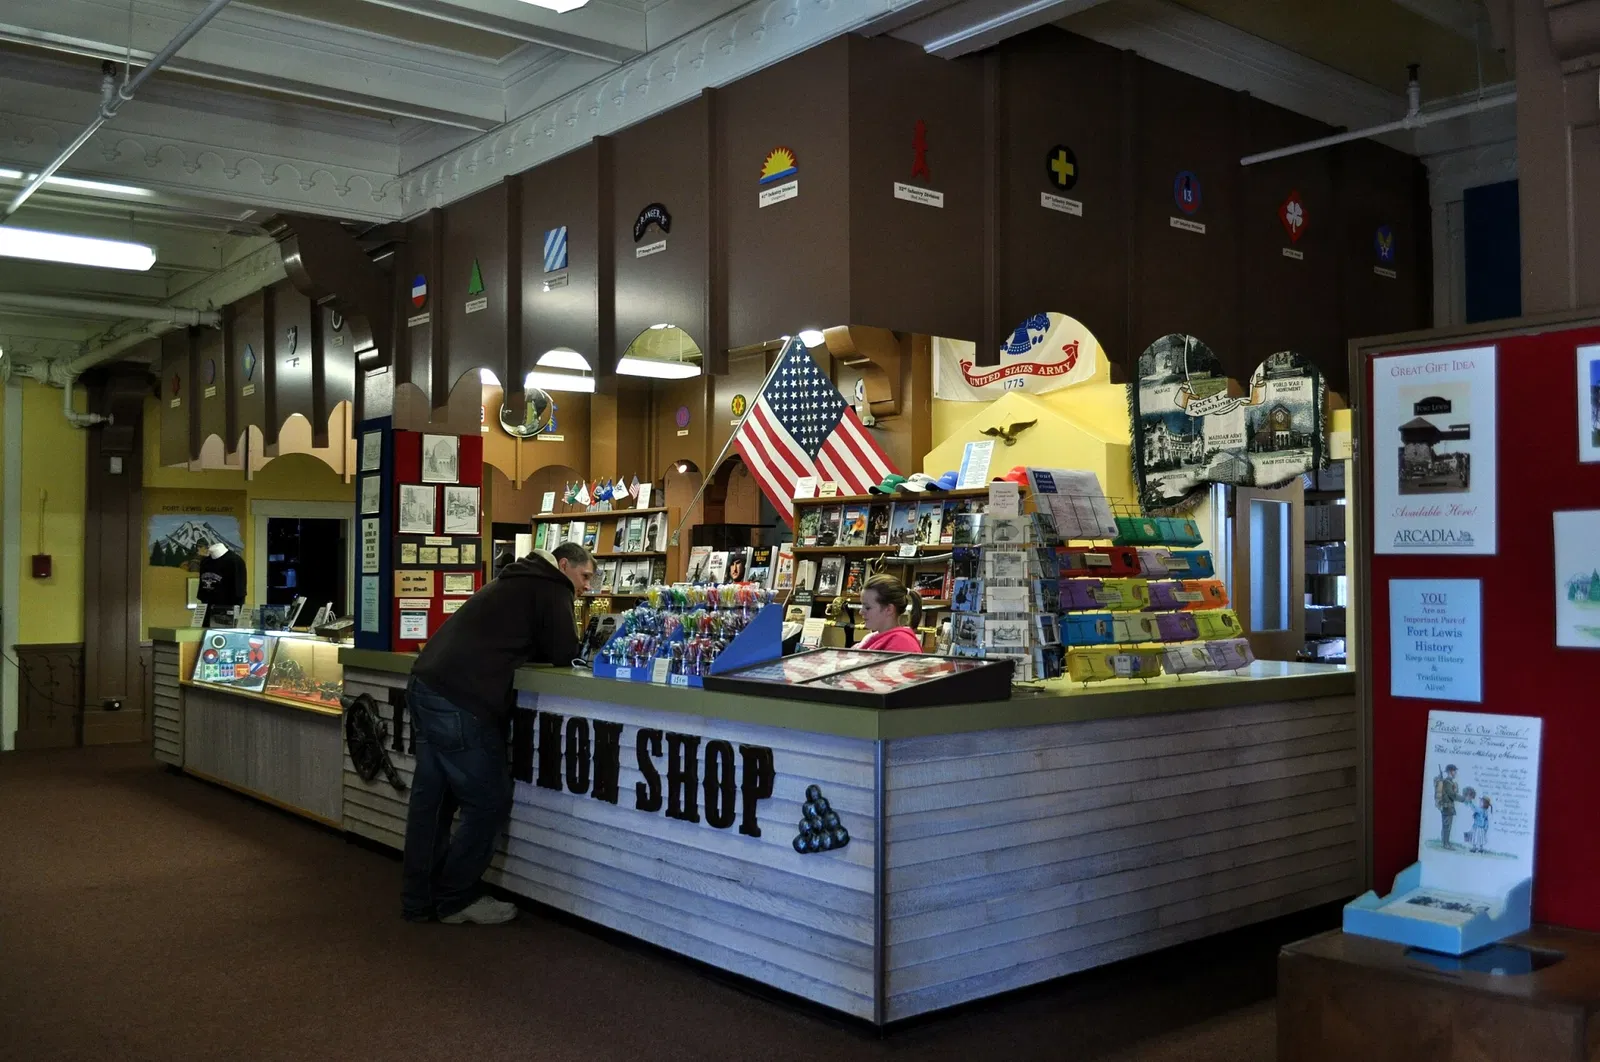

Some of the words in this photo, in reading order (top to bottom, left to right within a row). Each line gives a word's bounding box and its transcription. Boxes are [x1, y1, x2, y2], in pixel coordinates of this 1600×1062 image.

[1184, 188, 1192, 202] 13
[969, 372, 1000, 386] UNITED
[1004, 364, 1034, 376] STATES
[1038, 362, 1071, 375] ARMY
[1390, 366, 1424, 376] GREAT
[1425, 362, 1450, 374] GIFT
[1452, 360, 1476, 371] IDEA
[1004, 378, 1024, 390] 1775
[1189, 398, 1212, 411] Fort
[1392, 504, 1442, 518] Available
[1445, 504, 1478, 516] Here!
[1394, 528, 1455, 542] ARCADIA
[1421, 592, 1447, 605] YOU
[1404, 616, 1438, 624] Important
[1456, 616, 1466, 624] of
[1407, 626, 1428, 637] Fort
[1432, 627, 1463, 638] Lewis
[1415, 640, 1454, 654] History
[1405, 654, 1422, 662] Keep
[1438, 656, 1464, 664] History
[1416, 674, 1453, 682] Traditions
[1430, 720, 1460, 732] Please
[1476, 725, 1491, 734] Our
[1464, 737, 1476, 745] the
[1506, 742, 1518, 750] of
[1498, 751, 1529, 760] Museum
[508, 706, 624, 805] NNON
[636, 728, 776, 838] SHOP
